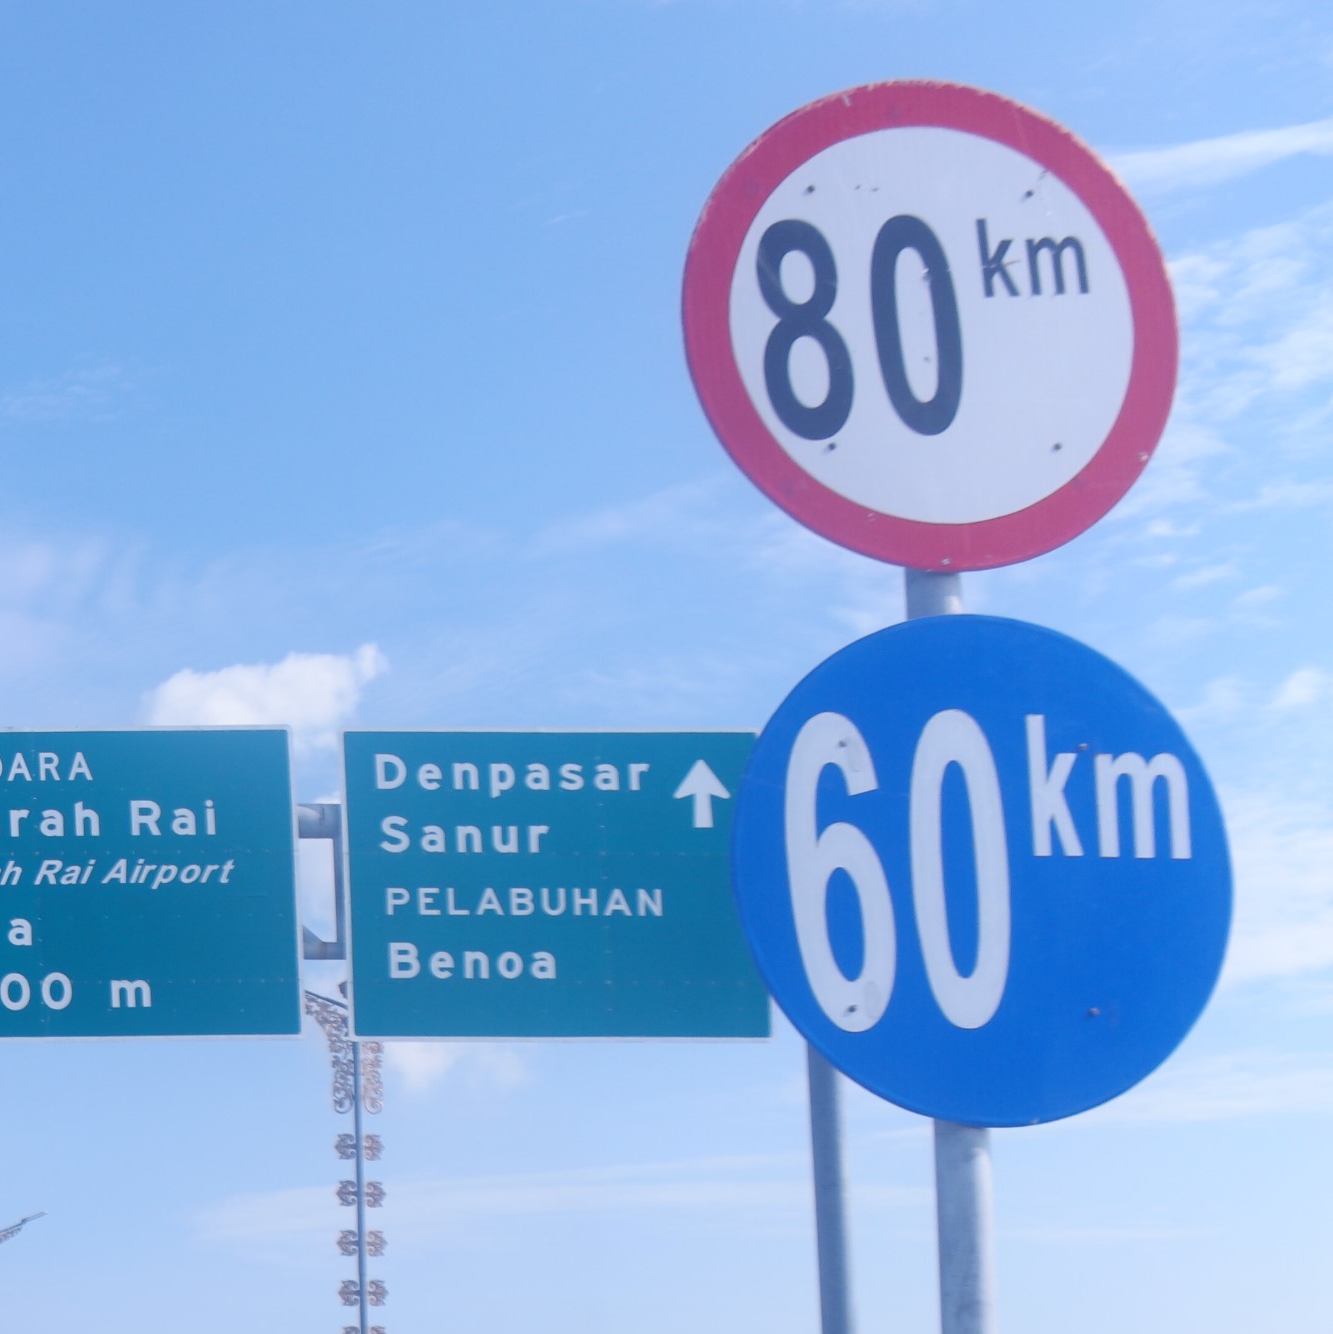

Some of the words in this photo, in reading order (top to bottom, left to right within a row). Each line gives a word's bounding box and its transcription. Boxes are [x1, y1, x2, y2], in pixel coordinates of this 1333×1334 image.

[756, 214, 964, 441] 80
[975, 217, 1090, 299] km
[373, 753, 650, 798] Denpasar
[130, 799, 216, 837] Rai
[379, 815, 550, 854] Sanur
[33, 858, 95, 886] Rai
[100, 858, 235, 890] Airport
[784, 708, 1012, 1033] 60
[1025, 713, 1193, 860] km
[385, 887, 664, 917] PELABUHAN
[388, 941, 557, 980] Benoa
[109, 978, 152, 1008] m
